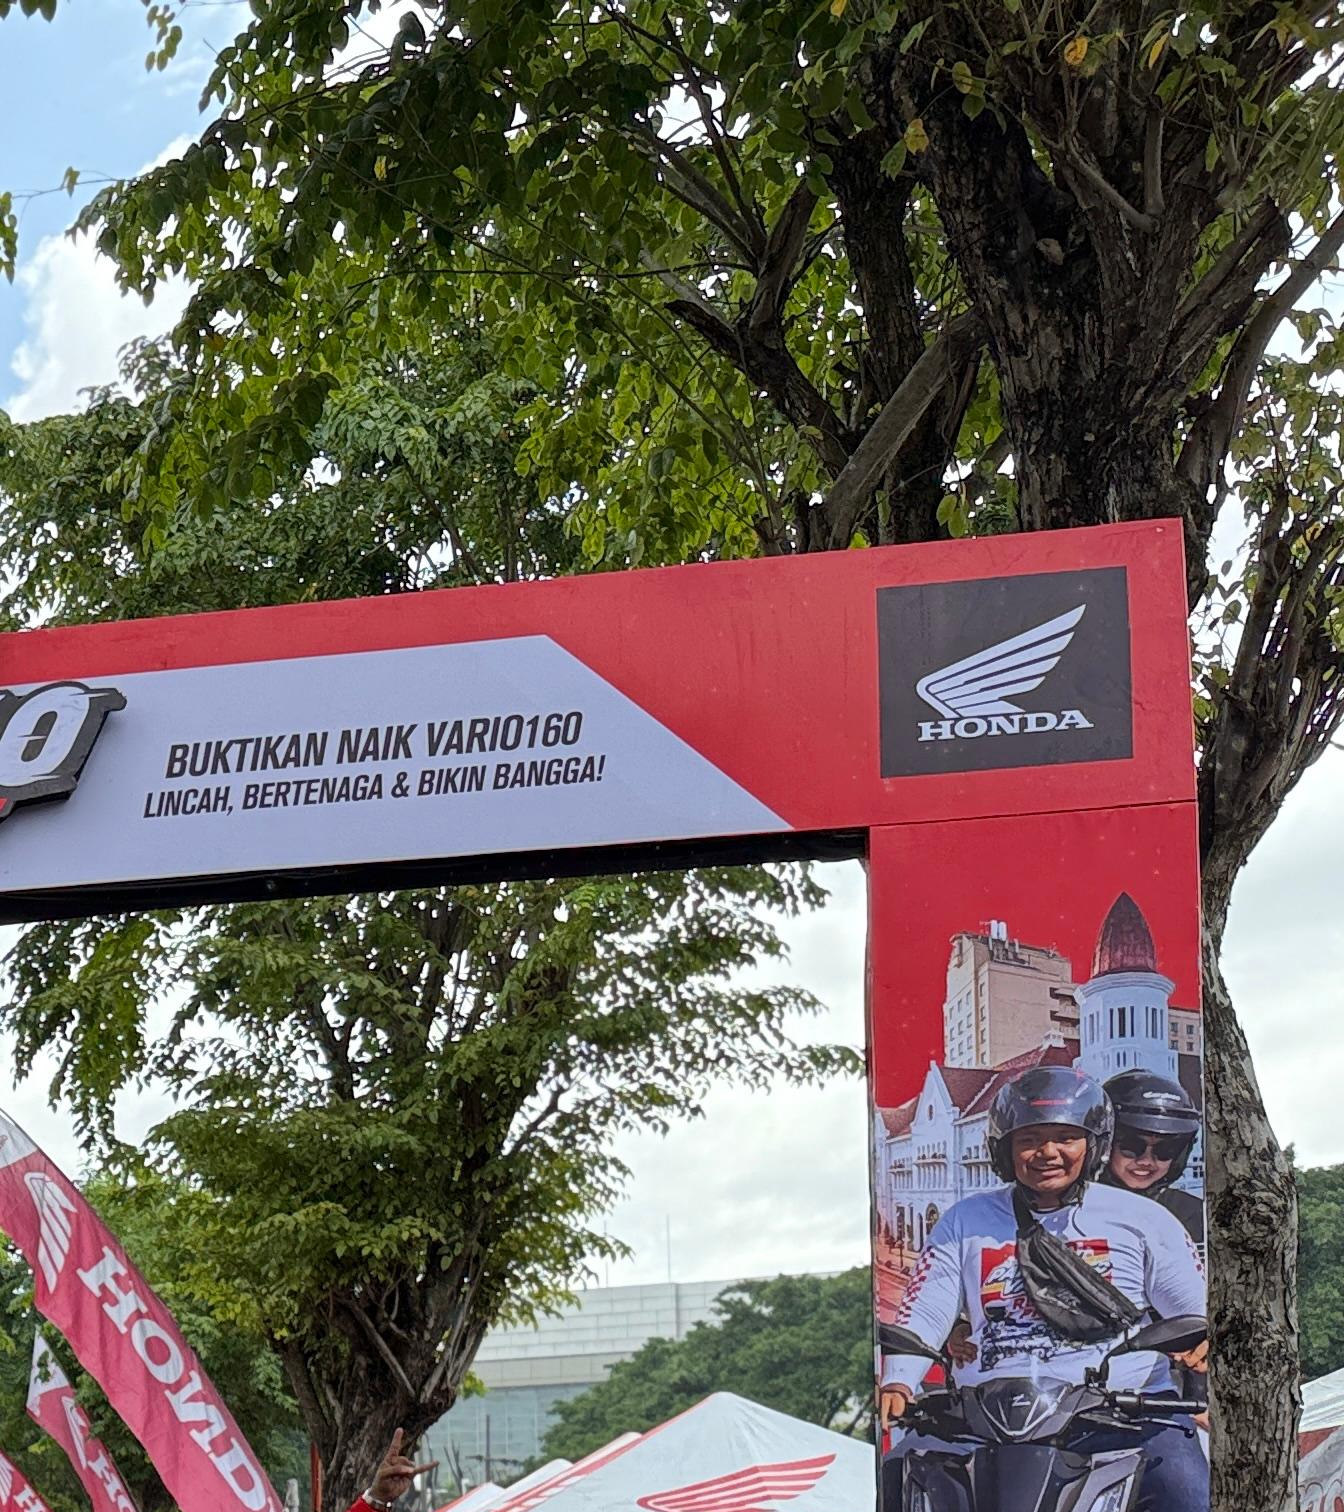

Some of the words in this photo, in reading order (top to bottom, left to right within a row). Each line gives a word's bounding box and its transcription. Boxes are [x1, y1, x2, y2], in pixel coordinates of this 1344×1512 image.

[165, 732, 328, 778] BUKTIKAN
[336, 724, 418, 765] NAIK
[426, 711, 584, 757] VARIO160
[917, 709, 1095, 741] HONDA
[143, 787, 234, 818] LINCAH,
[242, 773, 383, 810] BERTENAGA
[391, 773, 411, 798] &
[417, 764, 487, 796] BIKIN
[493, 755, 607, 789] BANGGA!
